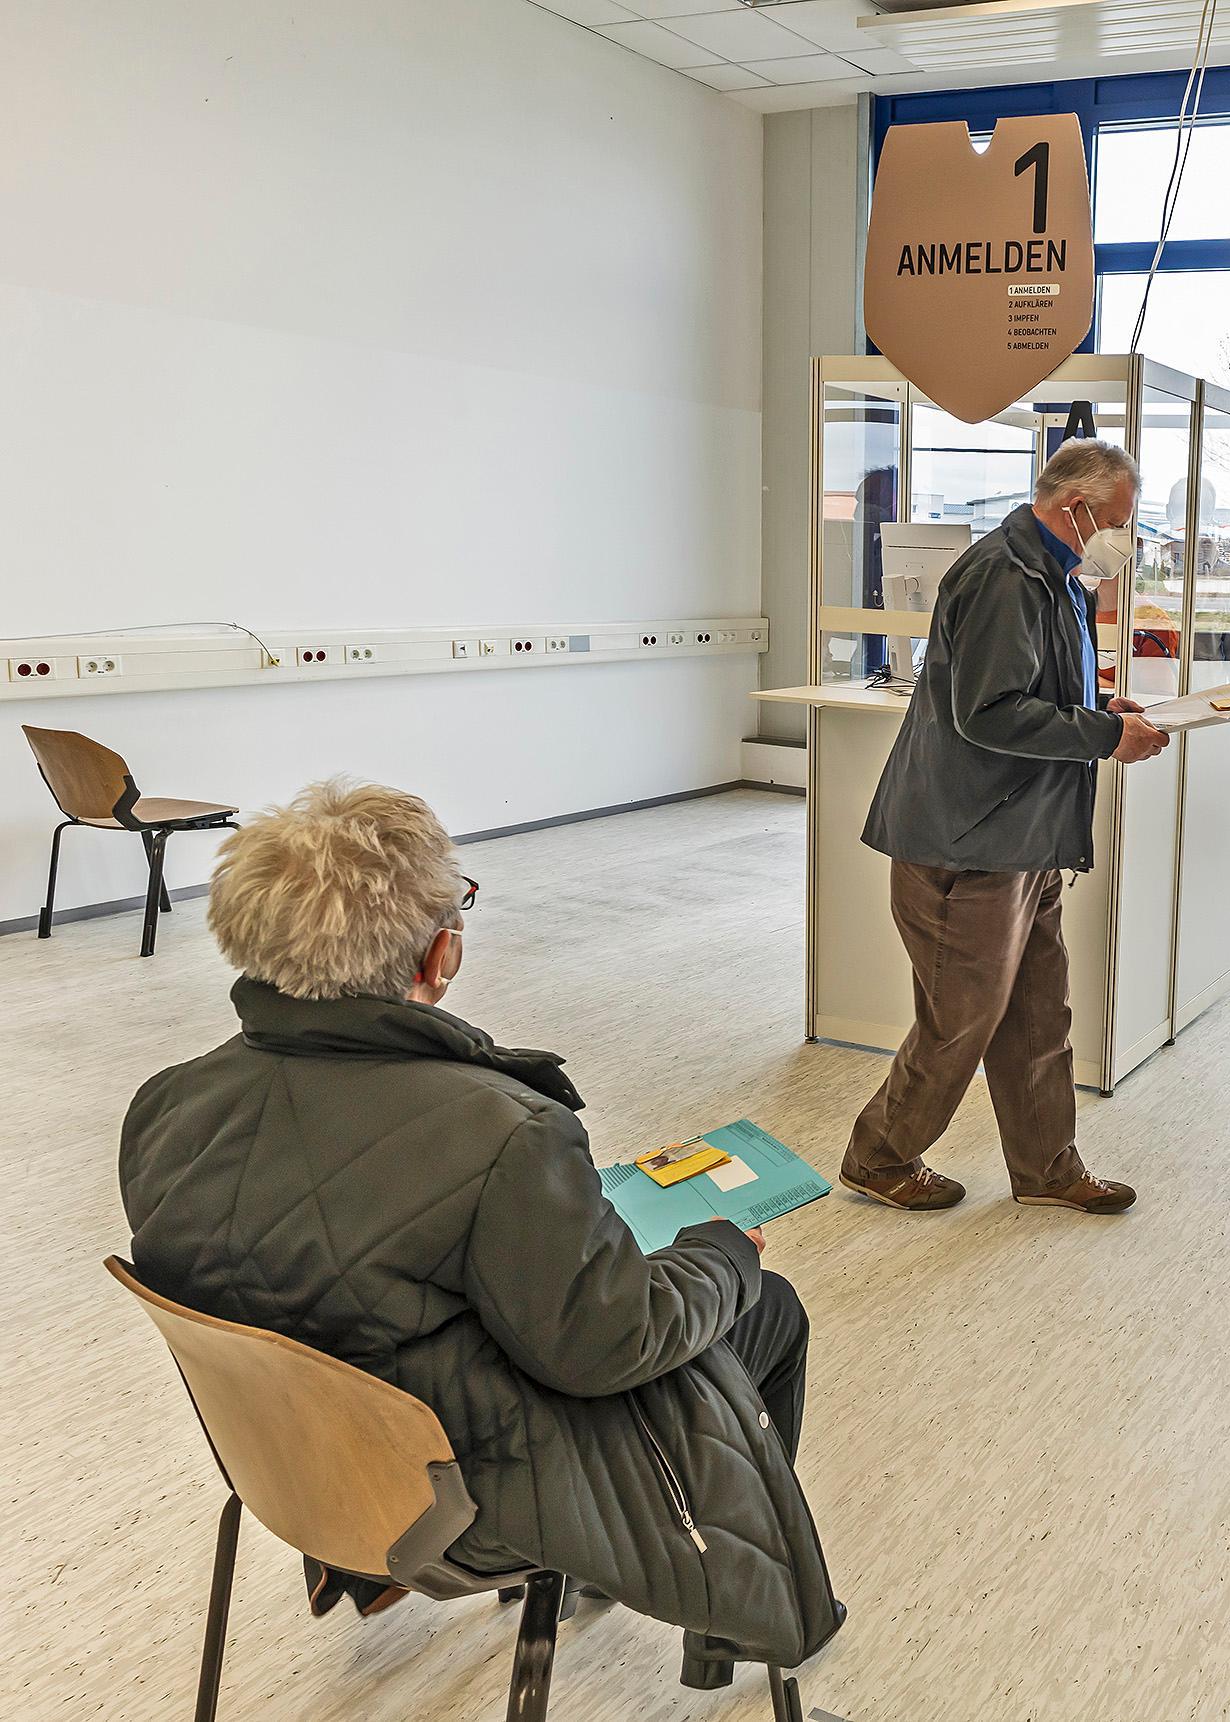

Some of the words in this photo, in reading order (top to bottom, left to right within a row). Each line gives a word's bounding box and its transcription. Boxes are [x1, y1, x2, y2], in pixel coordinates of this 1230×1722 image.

[1014, 141, 1050, 234] 1
[897, 239, 1067, 276] ANMELDEN
[1014, 286, 1051, 295] ANMELDEN
[1014, 299, 1053, 308] AUFKLÄREN
[1014, 314, 1040, 322] IMPFEN
[1013, 328, 1057, 336] BEOBACHTEN
[1013, 342, 1049, 350] ABMELDEN
